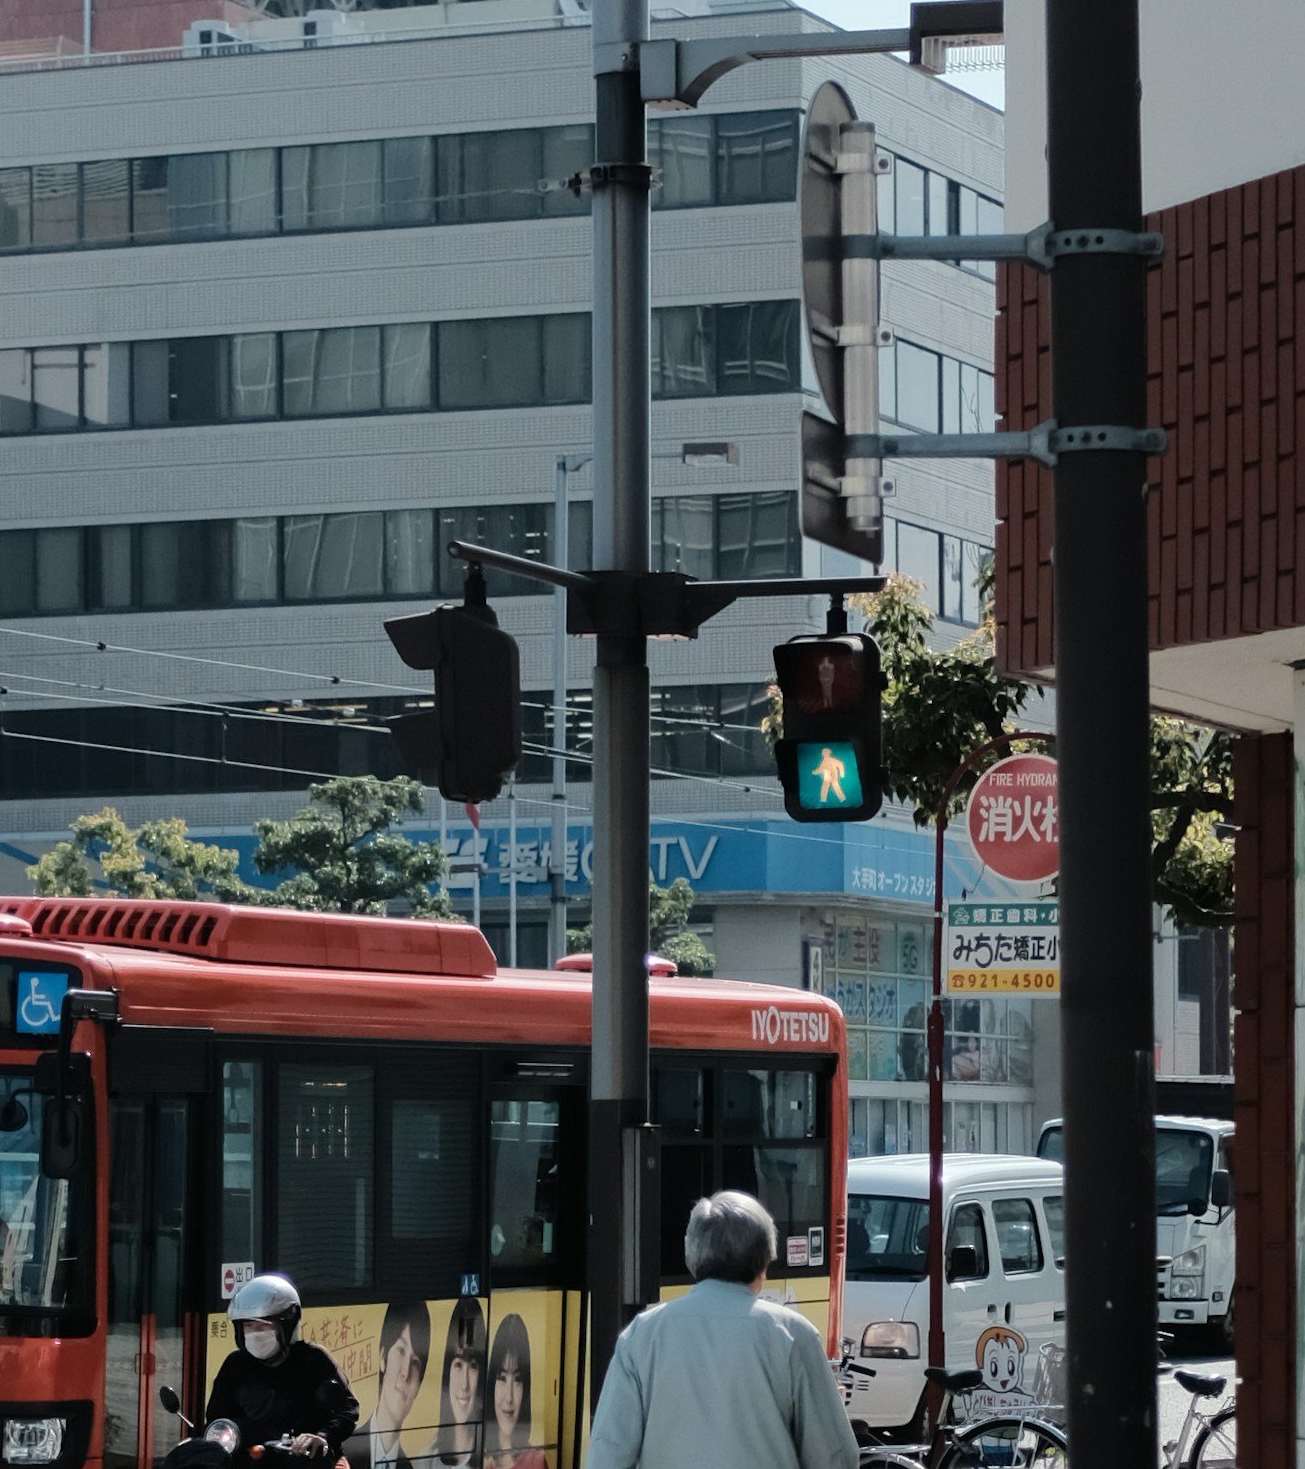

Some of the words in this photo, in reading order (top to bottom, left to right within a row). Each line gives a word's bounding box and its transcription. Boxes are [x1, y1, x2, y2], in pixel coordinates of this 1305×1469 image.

[989, 773, 1014, 787] FIRE
[1017, 772, 1058, 787] HYDRAN
[499, 835, 720, 884] 愛媛TV
[852, 865, 935, 898] 大手町オープンスタジ
[968, 973, 1055, 989] 921-4500
[751, 1006, 830, 1044] IYOTETSU
